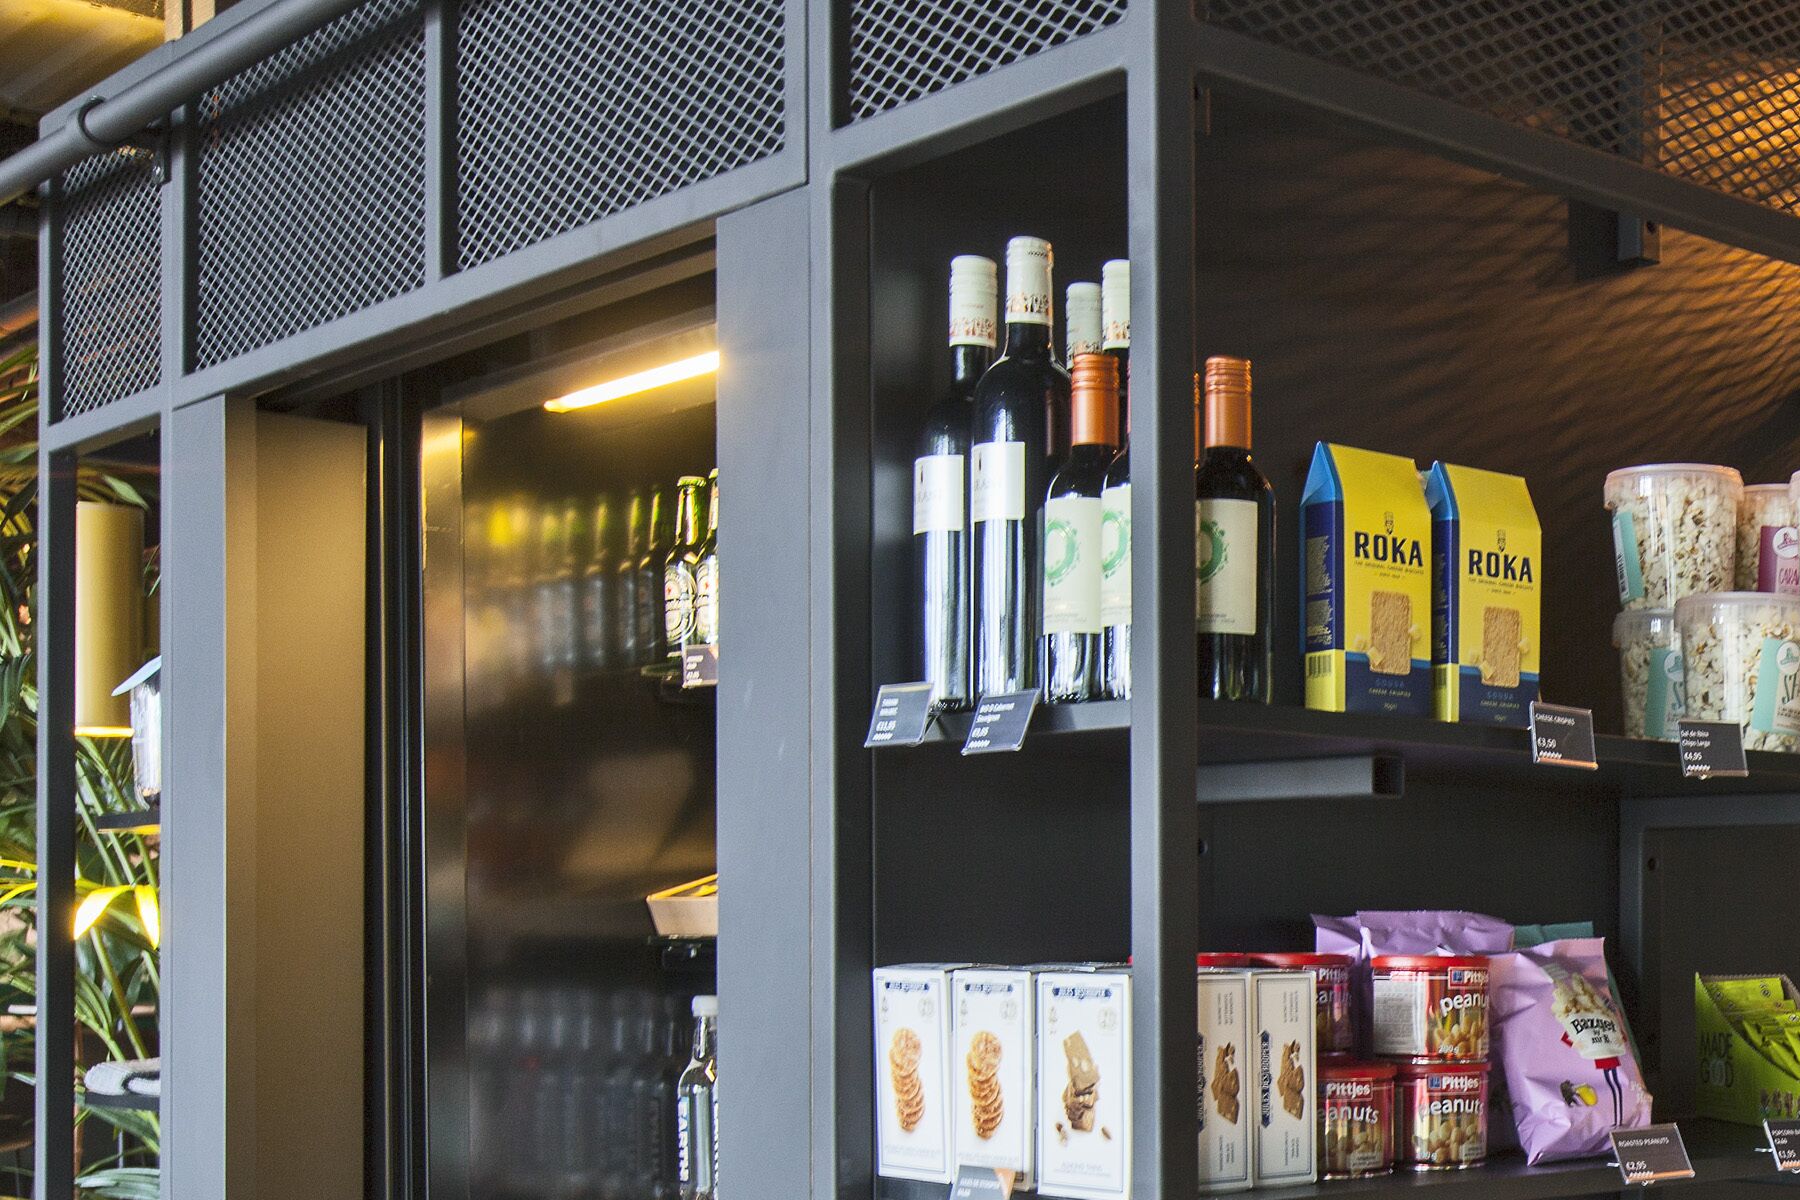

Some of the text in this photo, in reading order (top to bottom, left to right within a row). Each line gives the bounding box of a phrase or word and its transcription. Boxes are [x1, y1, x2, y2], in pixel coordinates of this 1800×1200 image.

[1355, 531, 1423, 567] ROKA
[1469, 549, 1533, 584] ROKA
[1701, 1032, 1734, 1061] MADE
[1327, 1081, 1371, 1099] Pittjes
[1442, 1076, 1480, 1091] Pittjes
